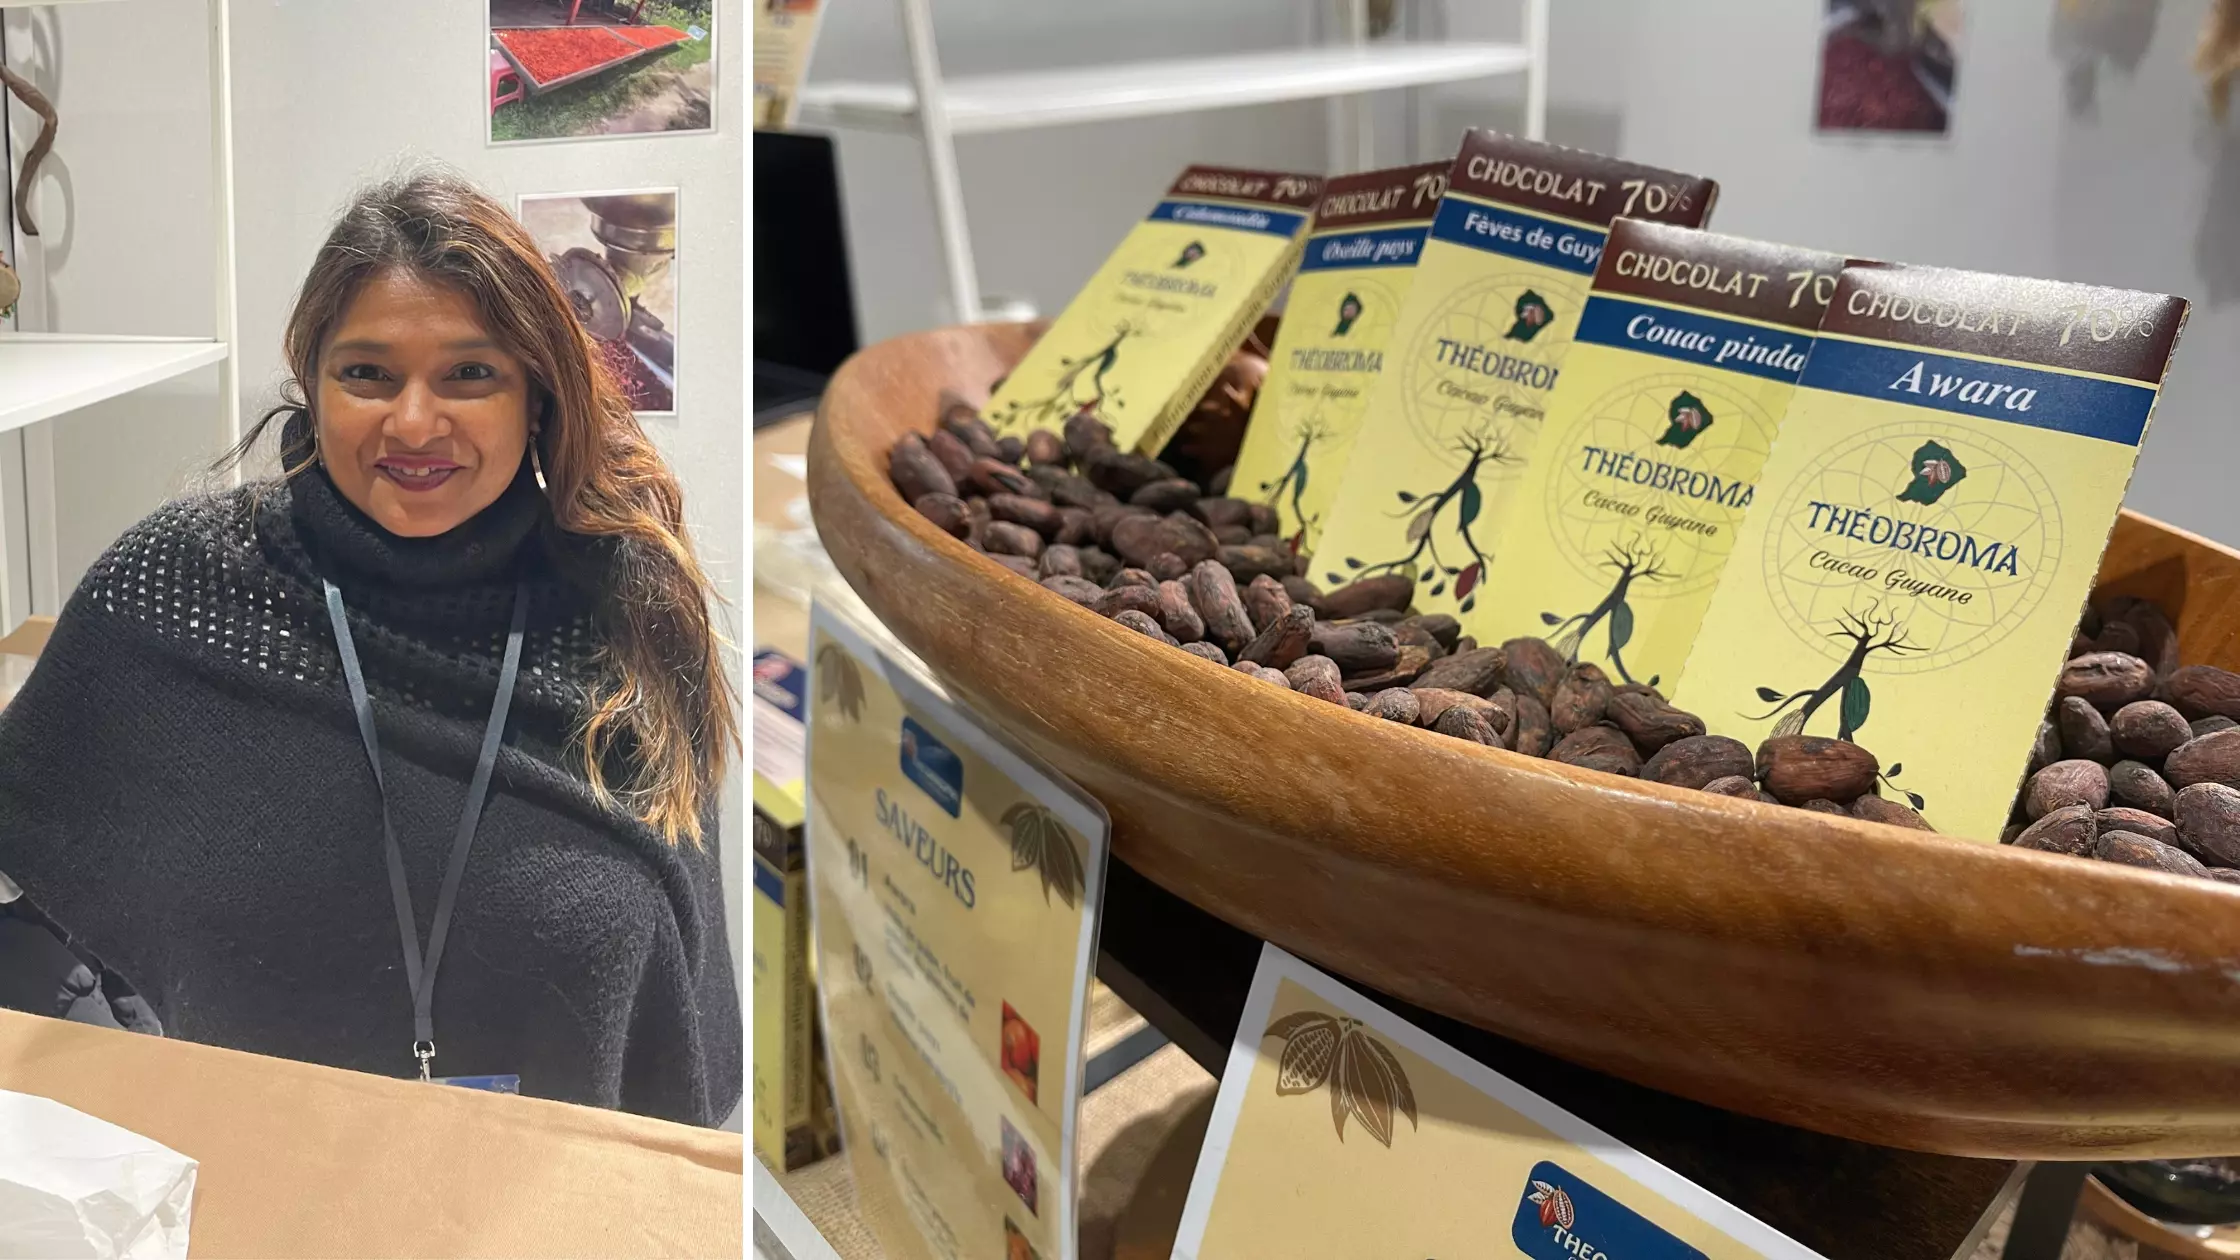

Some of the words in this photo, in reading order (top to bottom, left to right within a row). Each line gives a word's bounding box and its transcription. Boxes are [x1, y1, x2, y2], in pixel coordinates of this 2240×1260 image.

[1179, 172, 1269, 198] CHOCOLAT
[1320, 187, 1406, 219] CHOCOLAT
[1467, 156, 1606, 206] CHOCOLAT
[1620, 180, 1693, 216] 70%
[1463, 210, 1525, 243] Fèves
[1525, 226, 1555, 250] de
[1556, 233, 1603, 265] Guy
[1615, 250, 1769, 300] CHOCOLAT
[1786, 269, 1838, 309] 70
[1626, 313, 1717, 354] Couac
[1713, 336, 1807, 373] pinda
[1847, 289, 2031, 337] CHOCOLAT
[2056, 304, 2155, 347] 70%
[1888, 359, 2039, 413] Awara
[1582, 445, 1756, 509] THÉOBROMA
[1582, 489, 1641, 517] Cacao
[1645, 504, 1719, 538] Guyane
[1806, 499, 2020, 577] THÉOBROMA
[1808, 549, 1878, 581] Cacao
[1884, 568, 1973, 607] Guyane
[874, 787, 976, 910] SAVEURS
